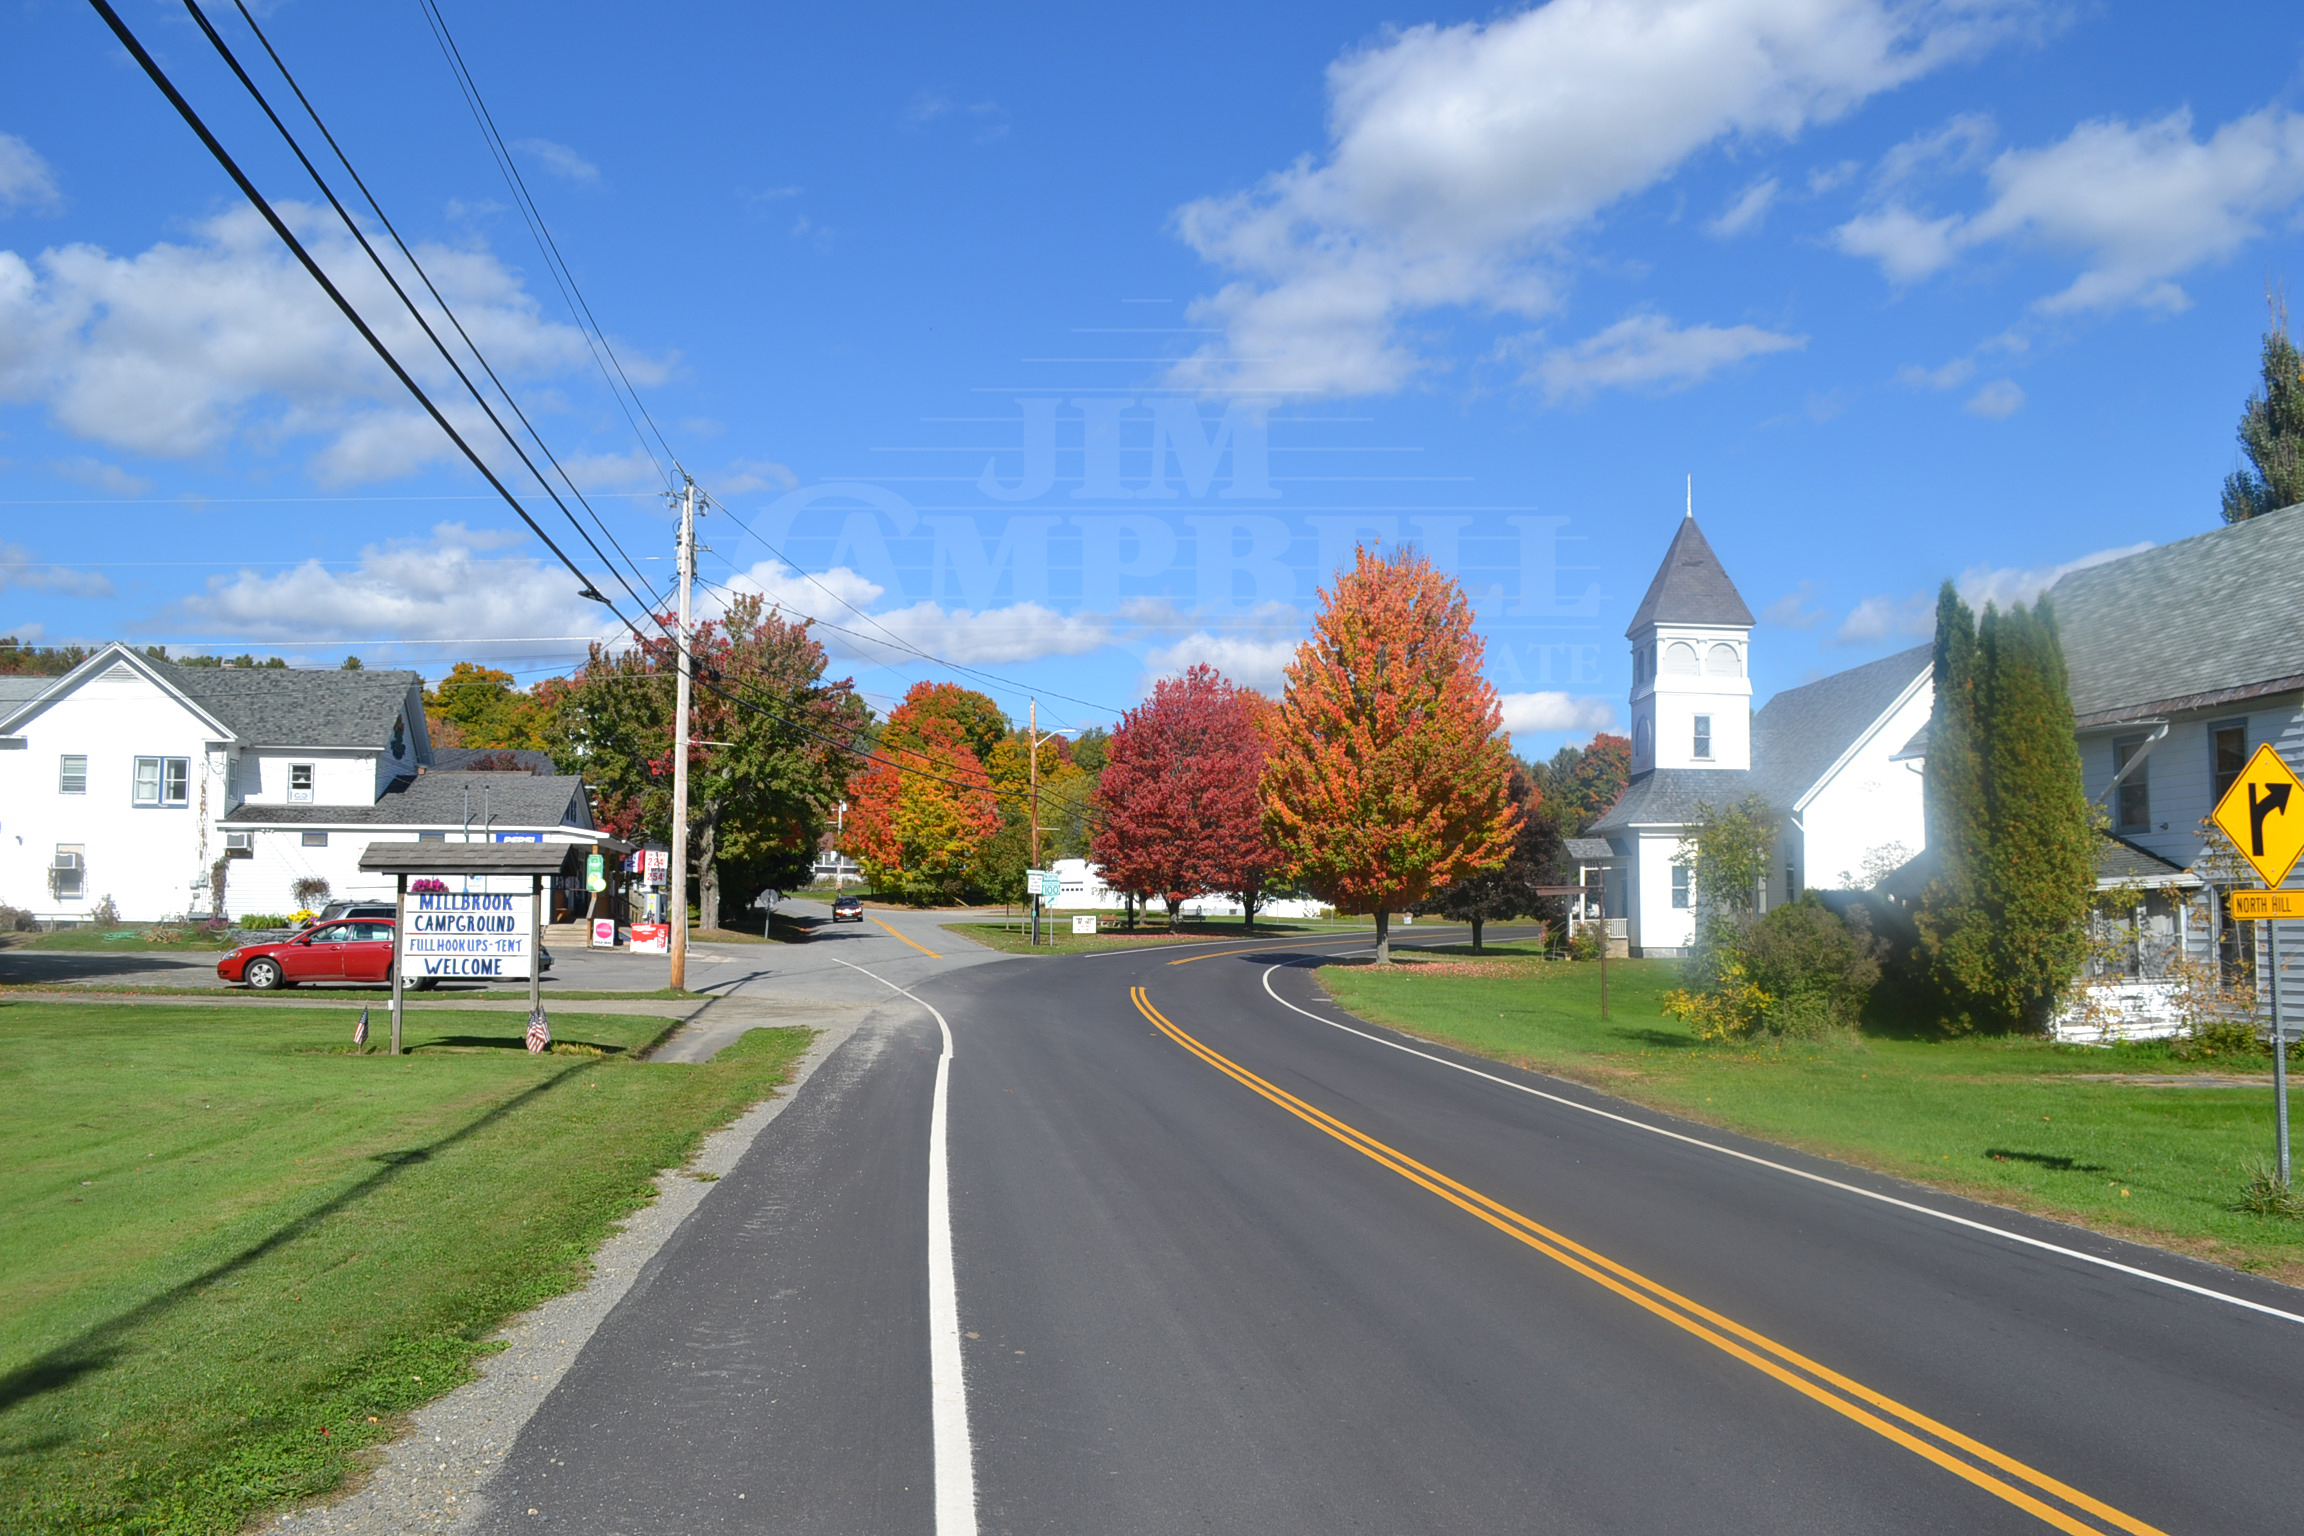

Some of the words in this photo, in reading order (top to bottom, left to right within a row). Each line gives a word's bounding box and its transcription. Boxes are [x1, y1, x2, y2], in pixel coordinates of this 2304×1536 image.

[1045, 886, 1059, 894] 100
[419, 893, 513, 911] MILLBROOK
[2237, 898, 2267, 913] NORTH
[2272, 898, 2292, 912] HILL
[414, 915, 515, 933] CAMPGROUND
[424, 958, 503, 976] WELCOME
